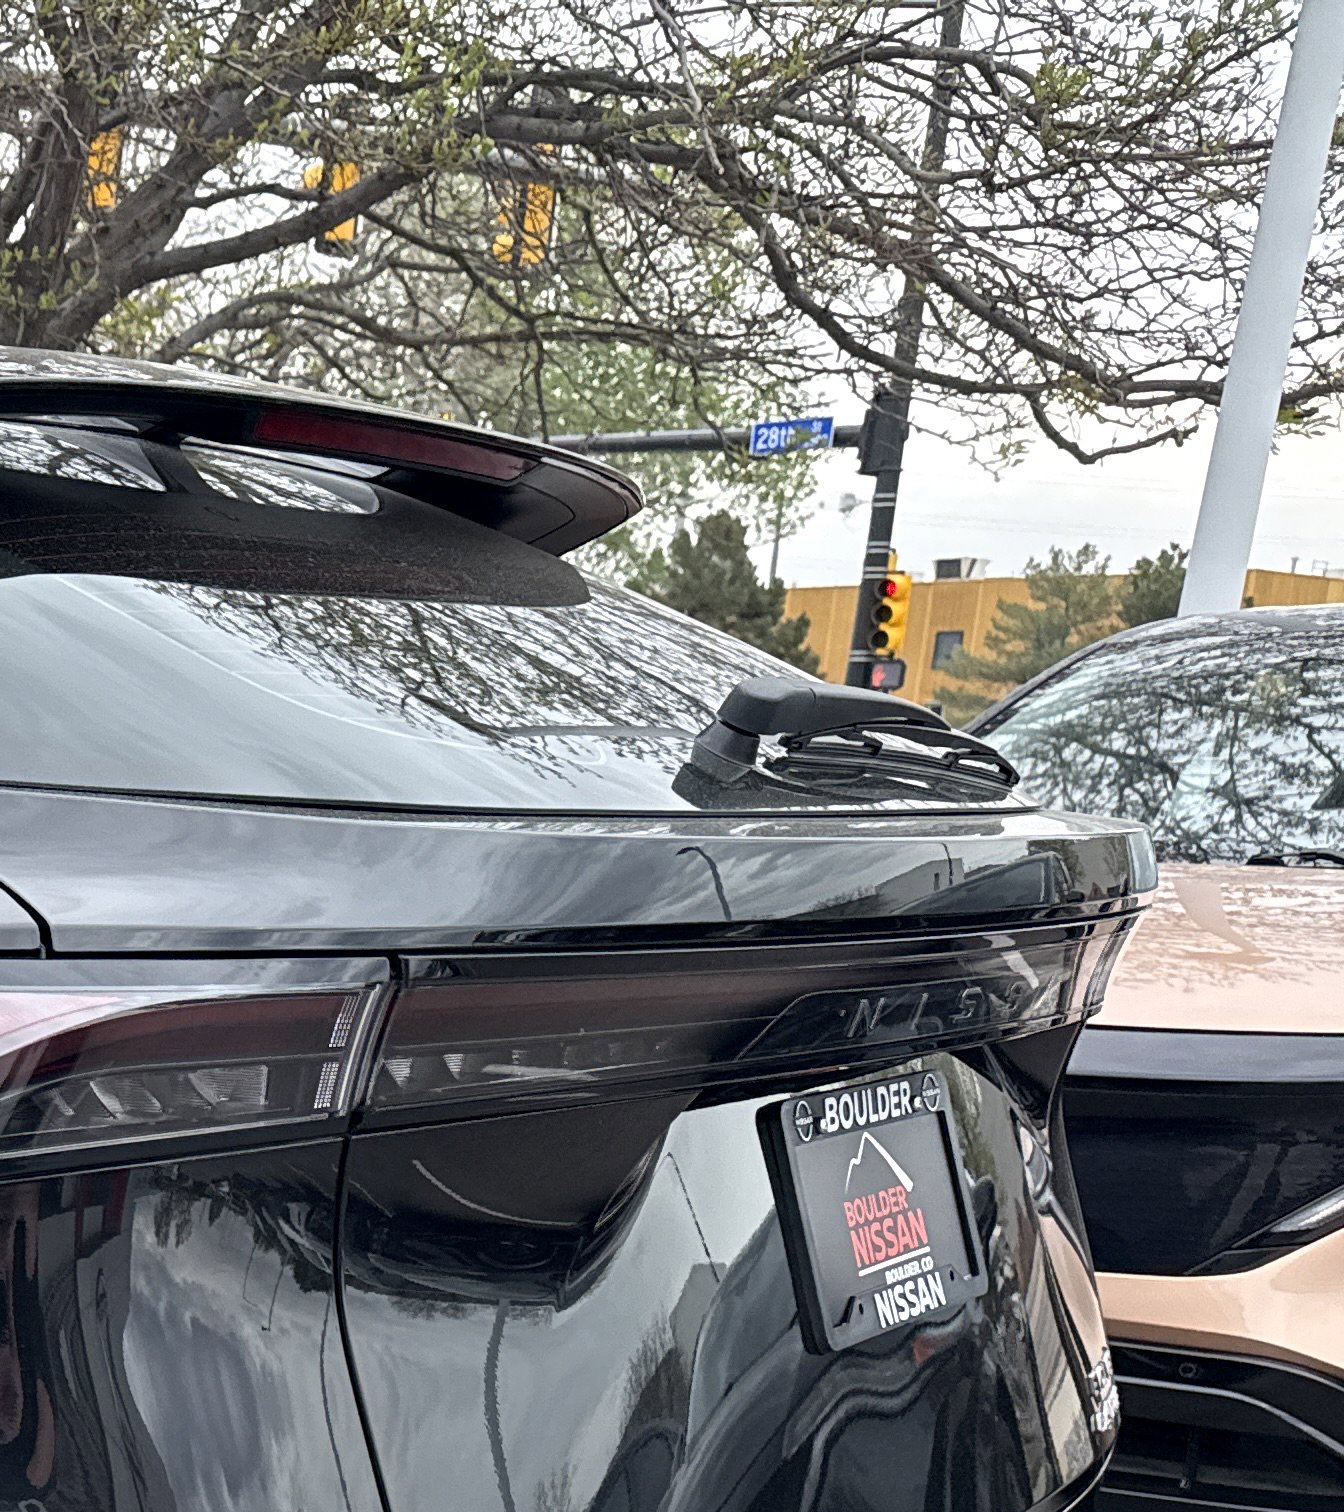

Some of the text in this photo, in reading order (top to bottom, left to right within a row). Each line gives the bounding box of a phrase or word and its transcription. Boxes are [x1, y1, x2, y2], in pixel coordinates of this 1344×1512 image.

[824, 1080, 913, 1133] BOULDER
[843, 1185, 909, 1229] BOULDER
[850, 1207, 929, 1269] NISSAN
[873, 1271, 947, 1329] NISSAN
